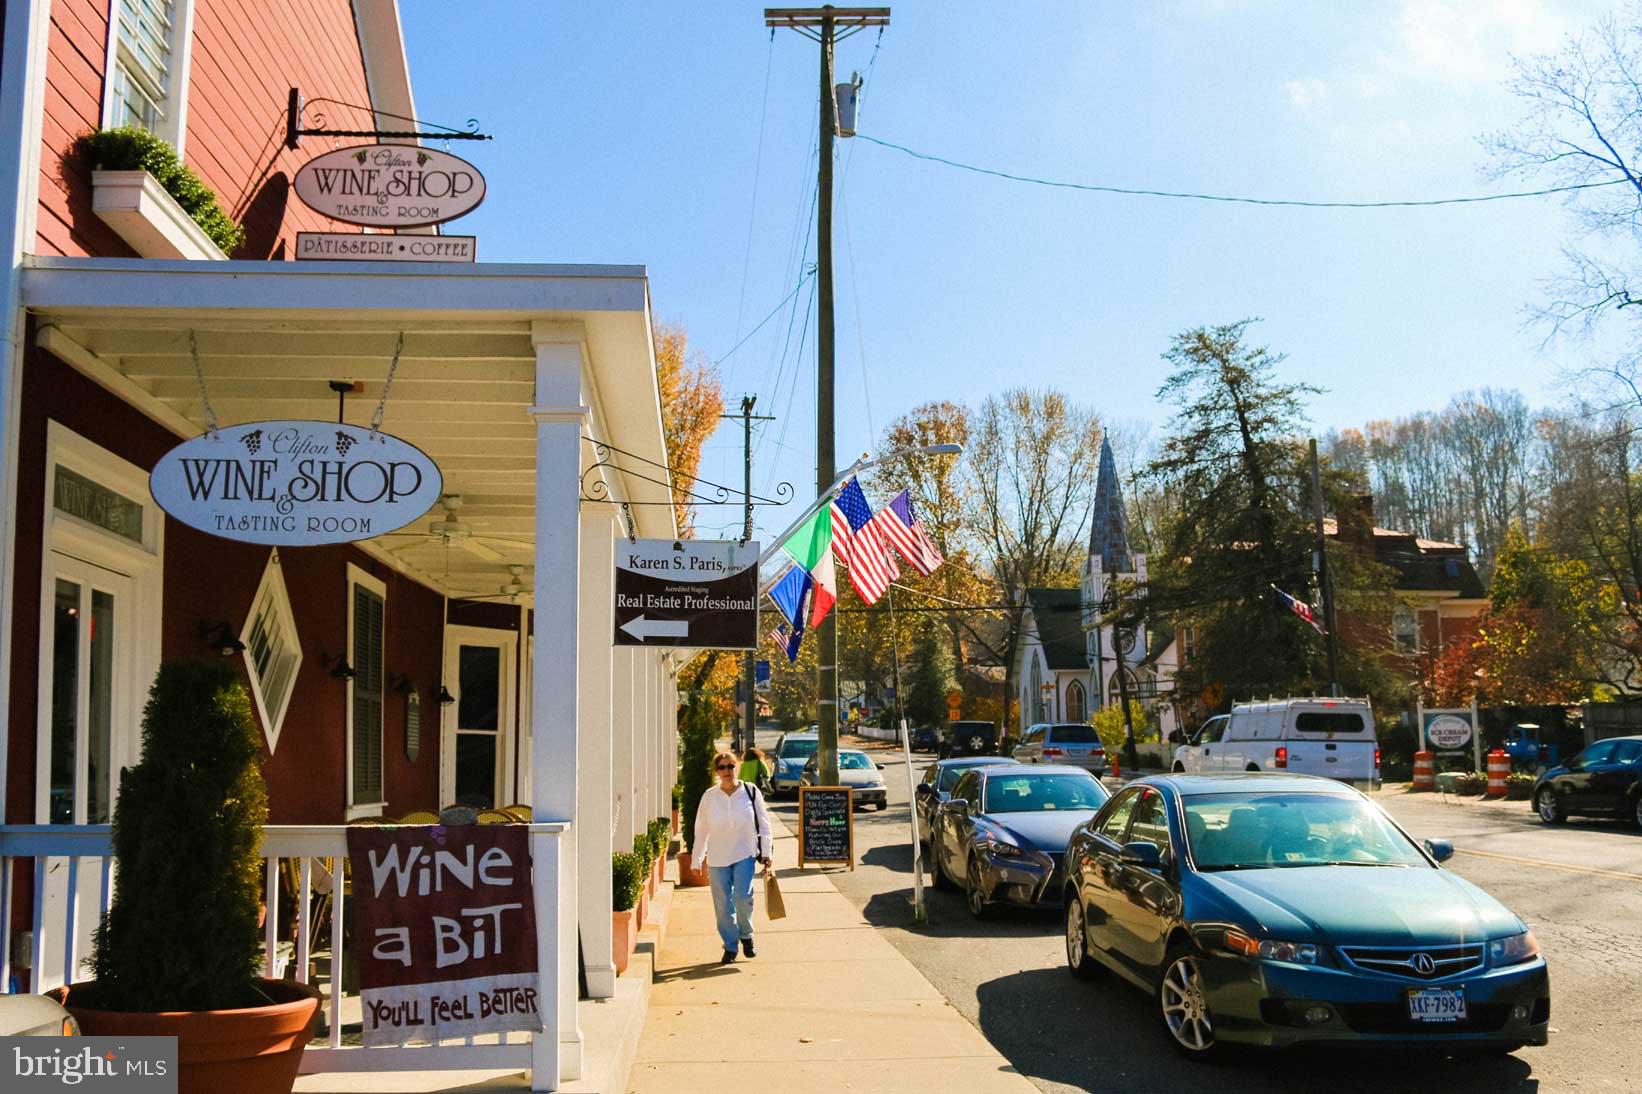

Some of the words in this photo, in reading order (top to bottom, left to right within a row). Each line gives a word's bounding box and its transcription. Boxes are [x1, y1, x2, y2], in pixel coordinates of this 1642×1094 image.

[371, 149, 412, 171] Clifton
[312, 168, 380, 196] WINE
[386, 170, 473, 198] SHOP
[336, 204, 390, 217] TASTING
[398, 206, 439, 218] ROOM
[304, 237, 393, 255] PÂTISSERIE
[410, 242, 468, 257] COFFEE
[268, 428, 329, 461] Clifton
[179, 458, 278, 501] WINE
[288, 460, 422, 504] SHOP
[276, 494, 295, 515] &
[215, 515, 296, 533] TASTING
[307, 517, 371, 534] ROOM
[629, 555, 669, 570] Karen
[673, 556, 685, 570] S.
[690, 556, 727, 574] Paris,
[618, 594, 643, 608] Real
[647, 594, 681, 609] Estate
[684, 595, 755, 610] Professional
[373, 927, 412, 967] a
